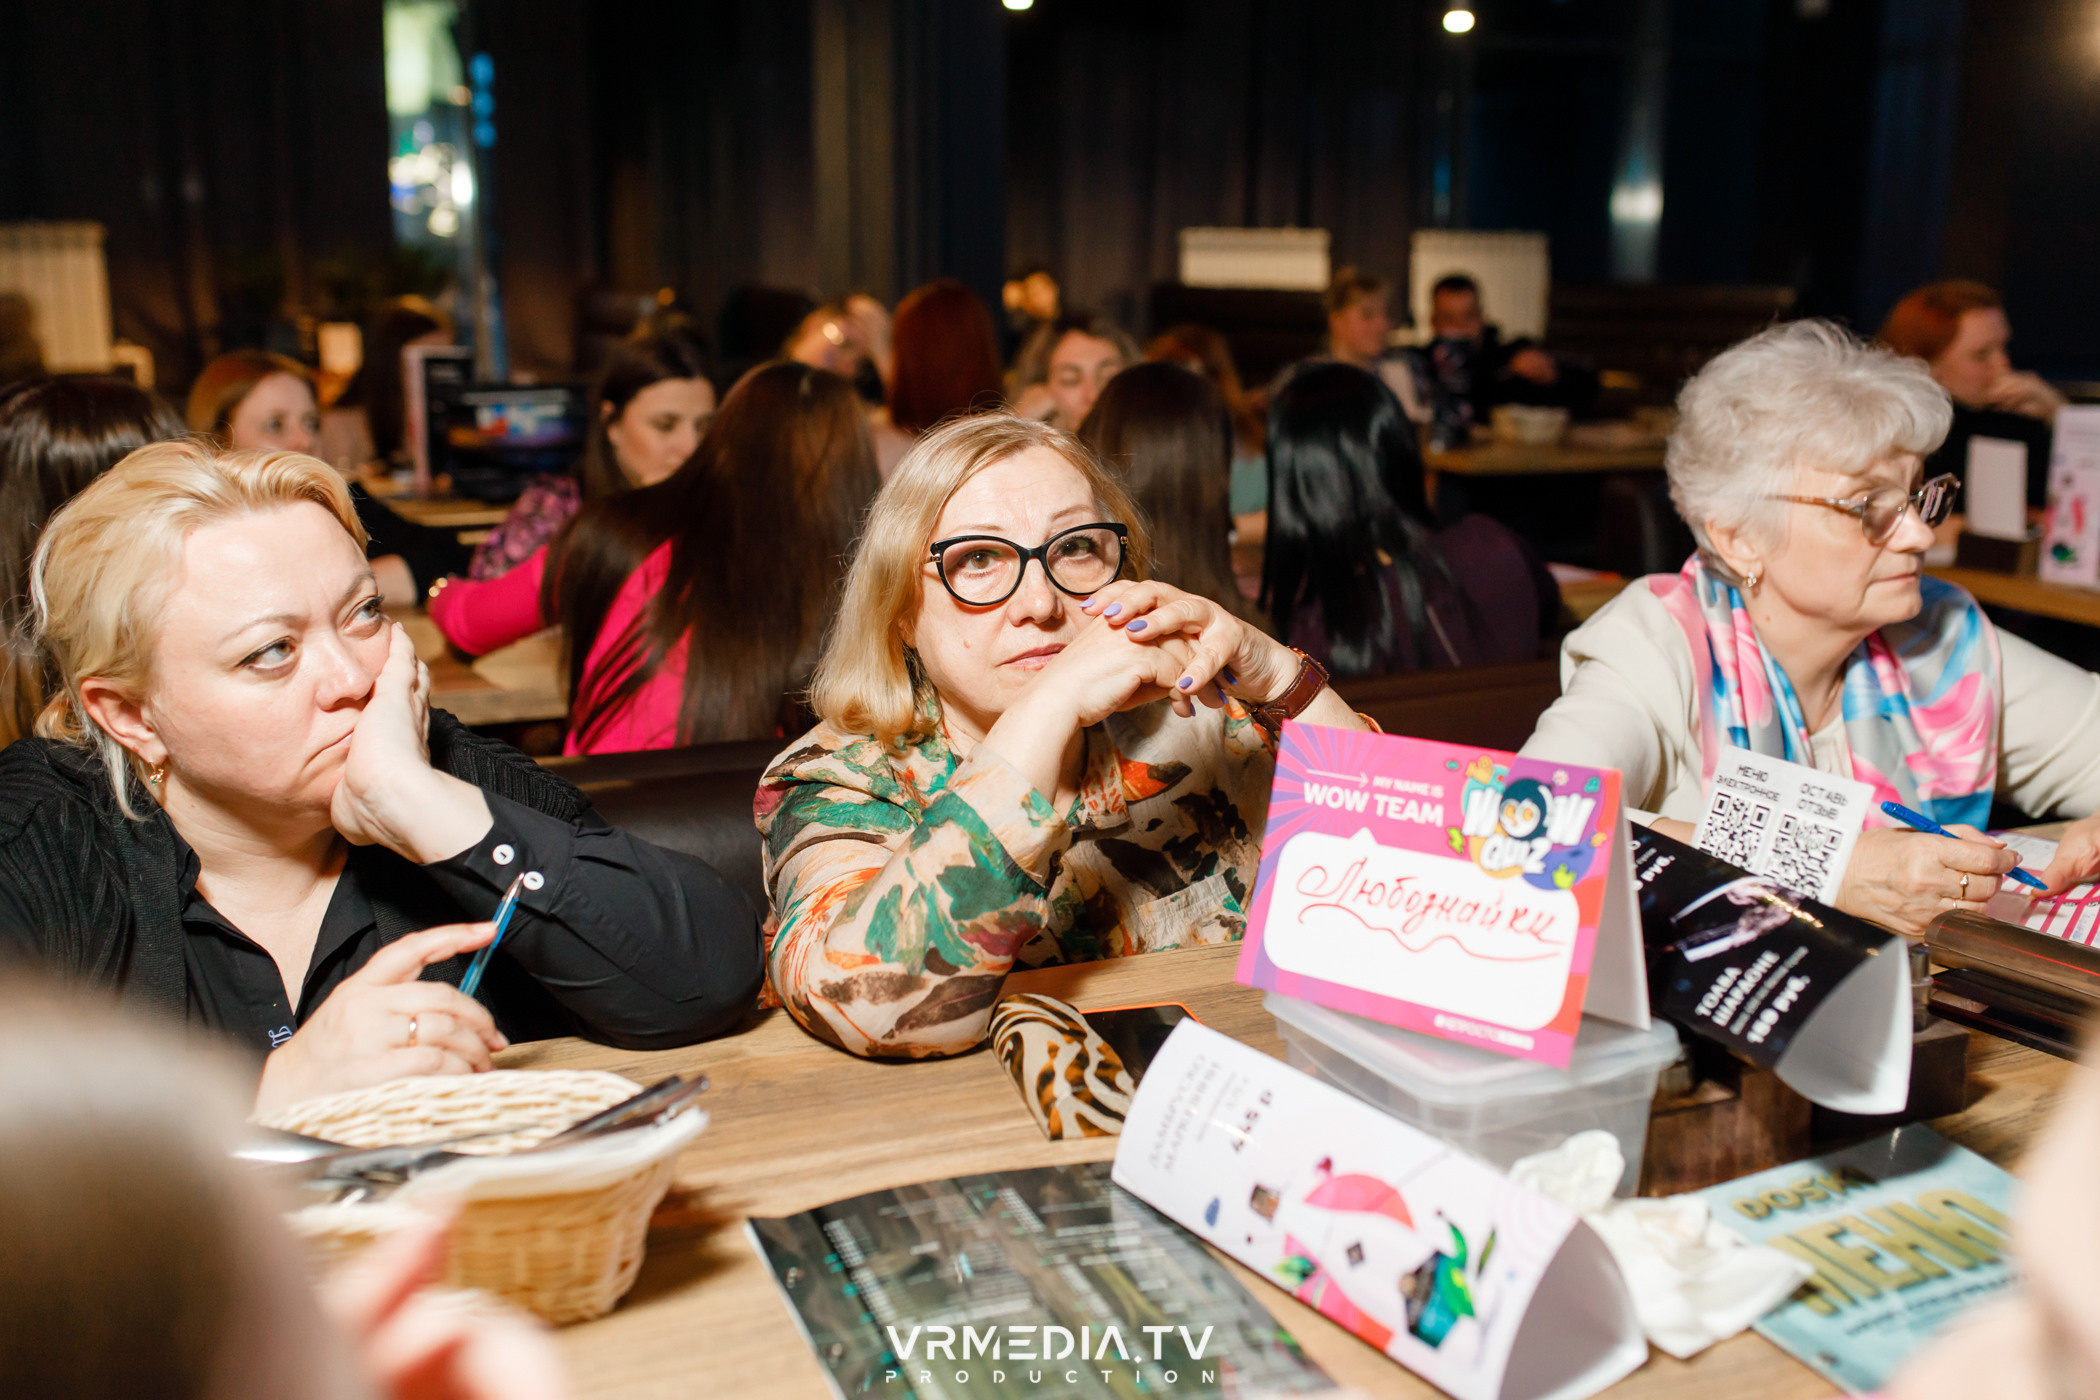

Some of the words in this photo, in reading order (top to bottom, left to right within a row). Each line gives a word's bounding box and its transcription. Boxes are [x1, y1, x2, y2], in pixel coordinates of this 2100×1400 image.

[1737, 763, 1769, 783] МЕНЮ
[1373, 776, 1394, 789] MY
[1393, 779, 1430, 796] NAME
[1431, 784, 1445, 799] IS
[1716, 774, 1781, 803] ЭЛЕКТРОННОЕ
[1799, 783, 1849, 808] ОСТАВЬ
[1304, 781, 1370, 814] WOW
[1373, 793, 1445, 828] TEAM
[1797, 798, 1839, 821] ОТЗЫВ
[1480, 833, 1553, 874] QUIZ
